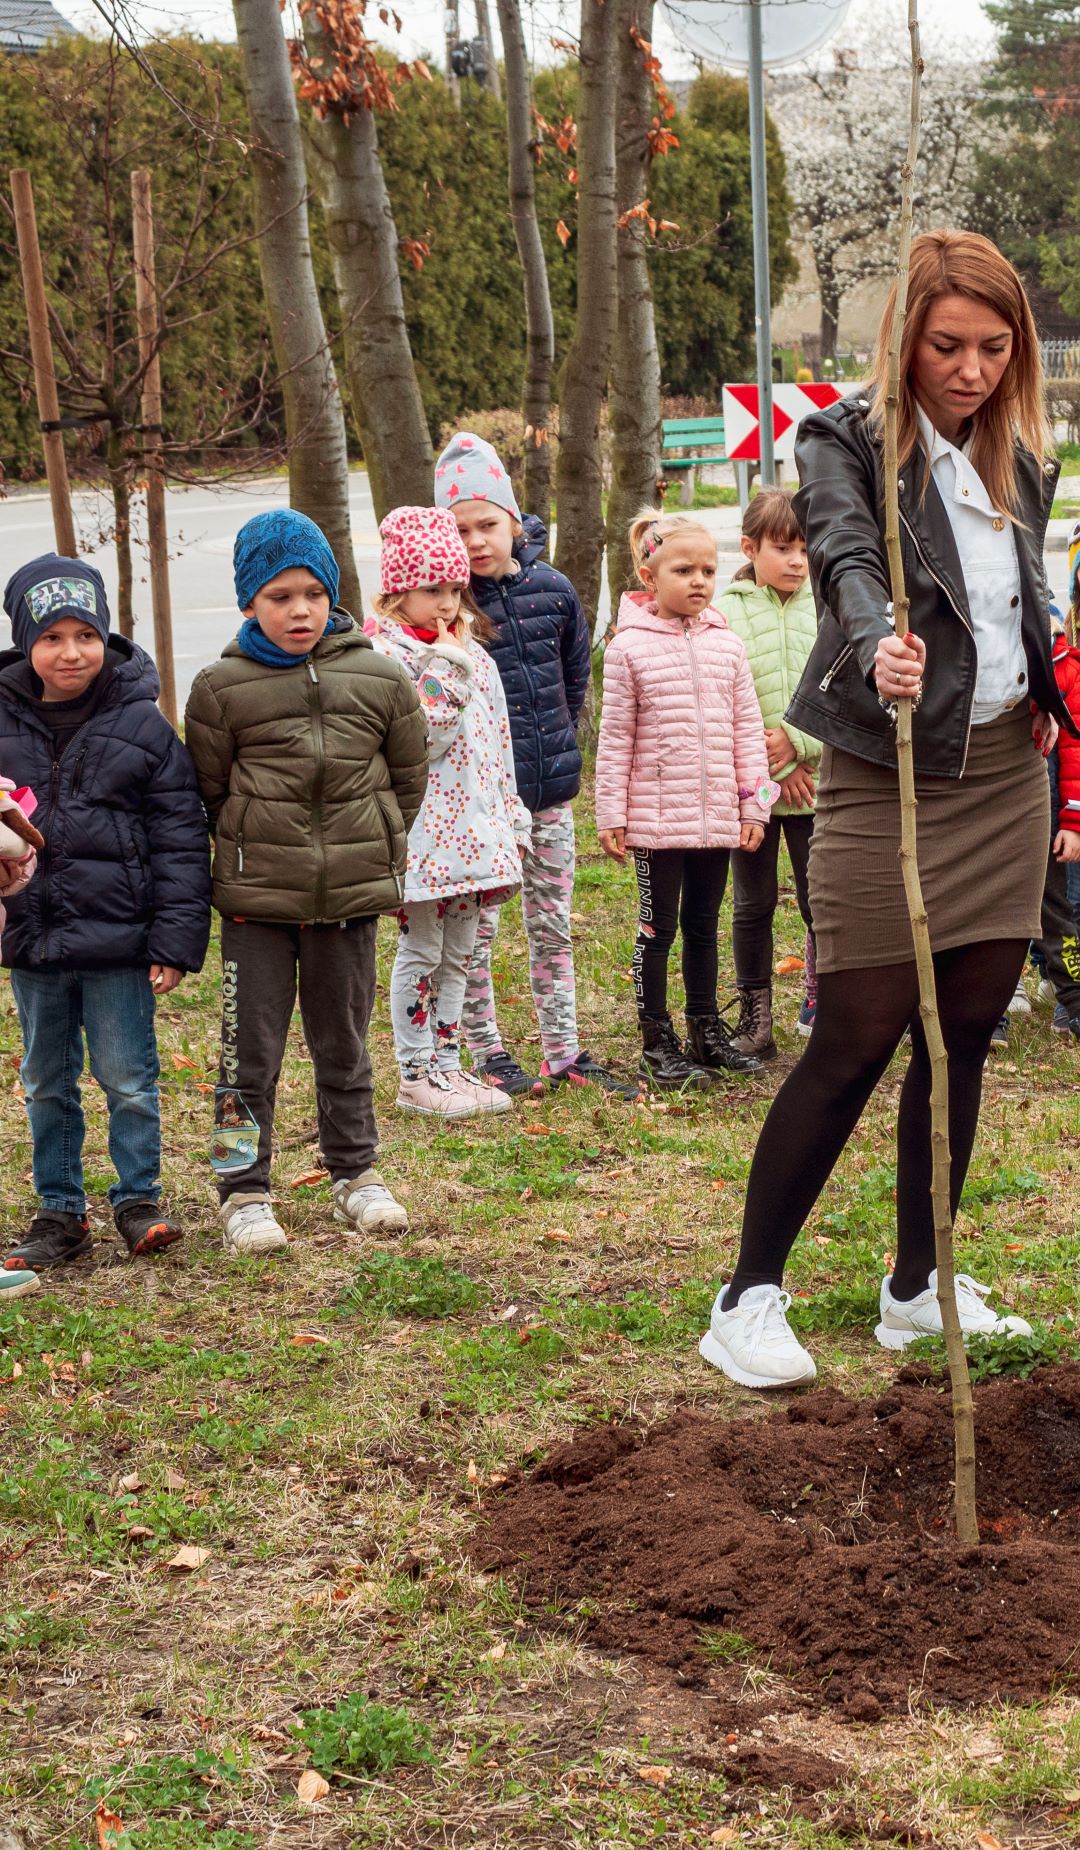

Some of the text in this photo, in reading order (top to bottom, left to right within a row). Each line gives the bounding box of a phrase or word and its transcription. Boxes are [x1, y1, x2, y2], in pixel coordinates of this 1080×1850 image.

[632, 848, 653, 1009] TEAM UNICO
[222, 960, 240, 1085] SCOOBY-DOO
